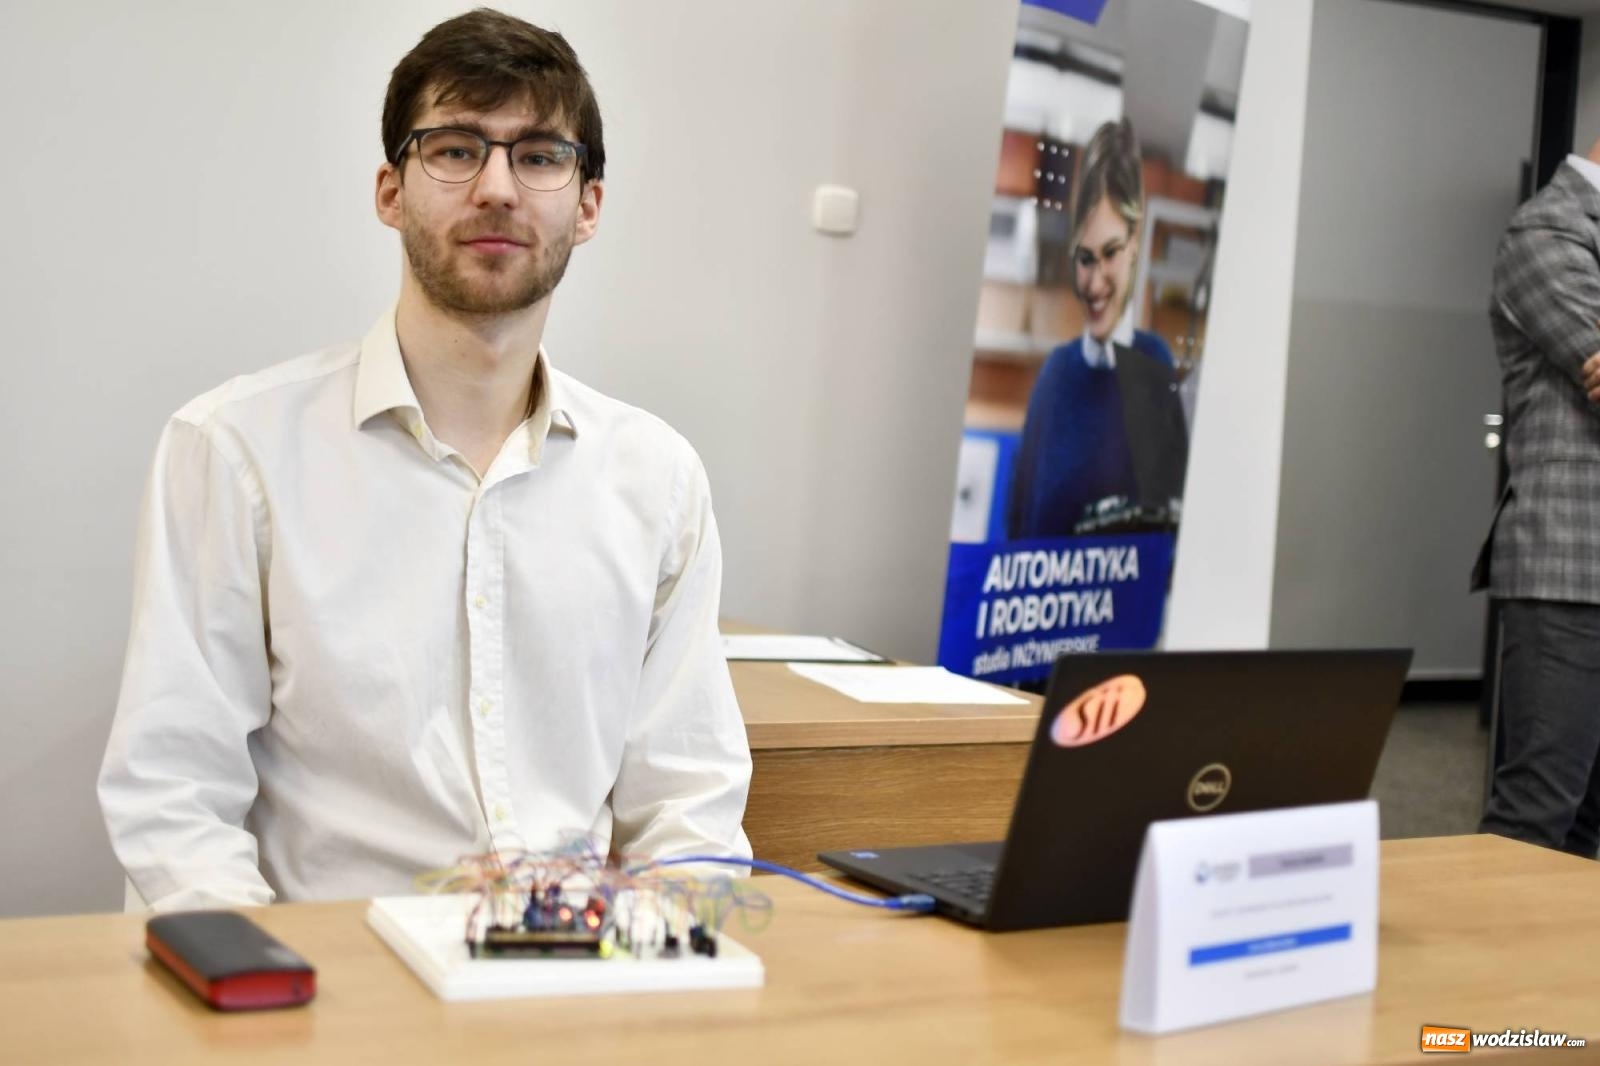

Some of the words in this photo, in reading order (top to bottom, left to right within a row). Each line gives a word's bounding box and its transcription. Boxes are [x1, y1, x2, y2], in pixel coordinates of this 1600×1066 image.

[982, 546, 1140, 593] AUTOMATYKA
[976, 600, 989, 639] I
[990, 588, 1114, 637] ROBOTYKA
[1195, 781, 1225, 795] DELL
